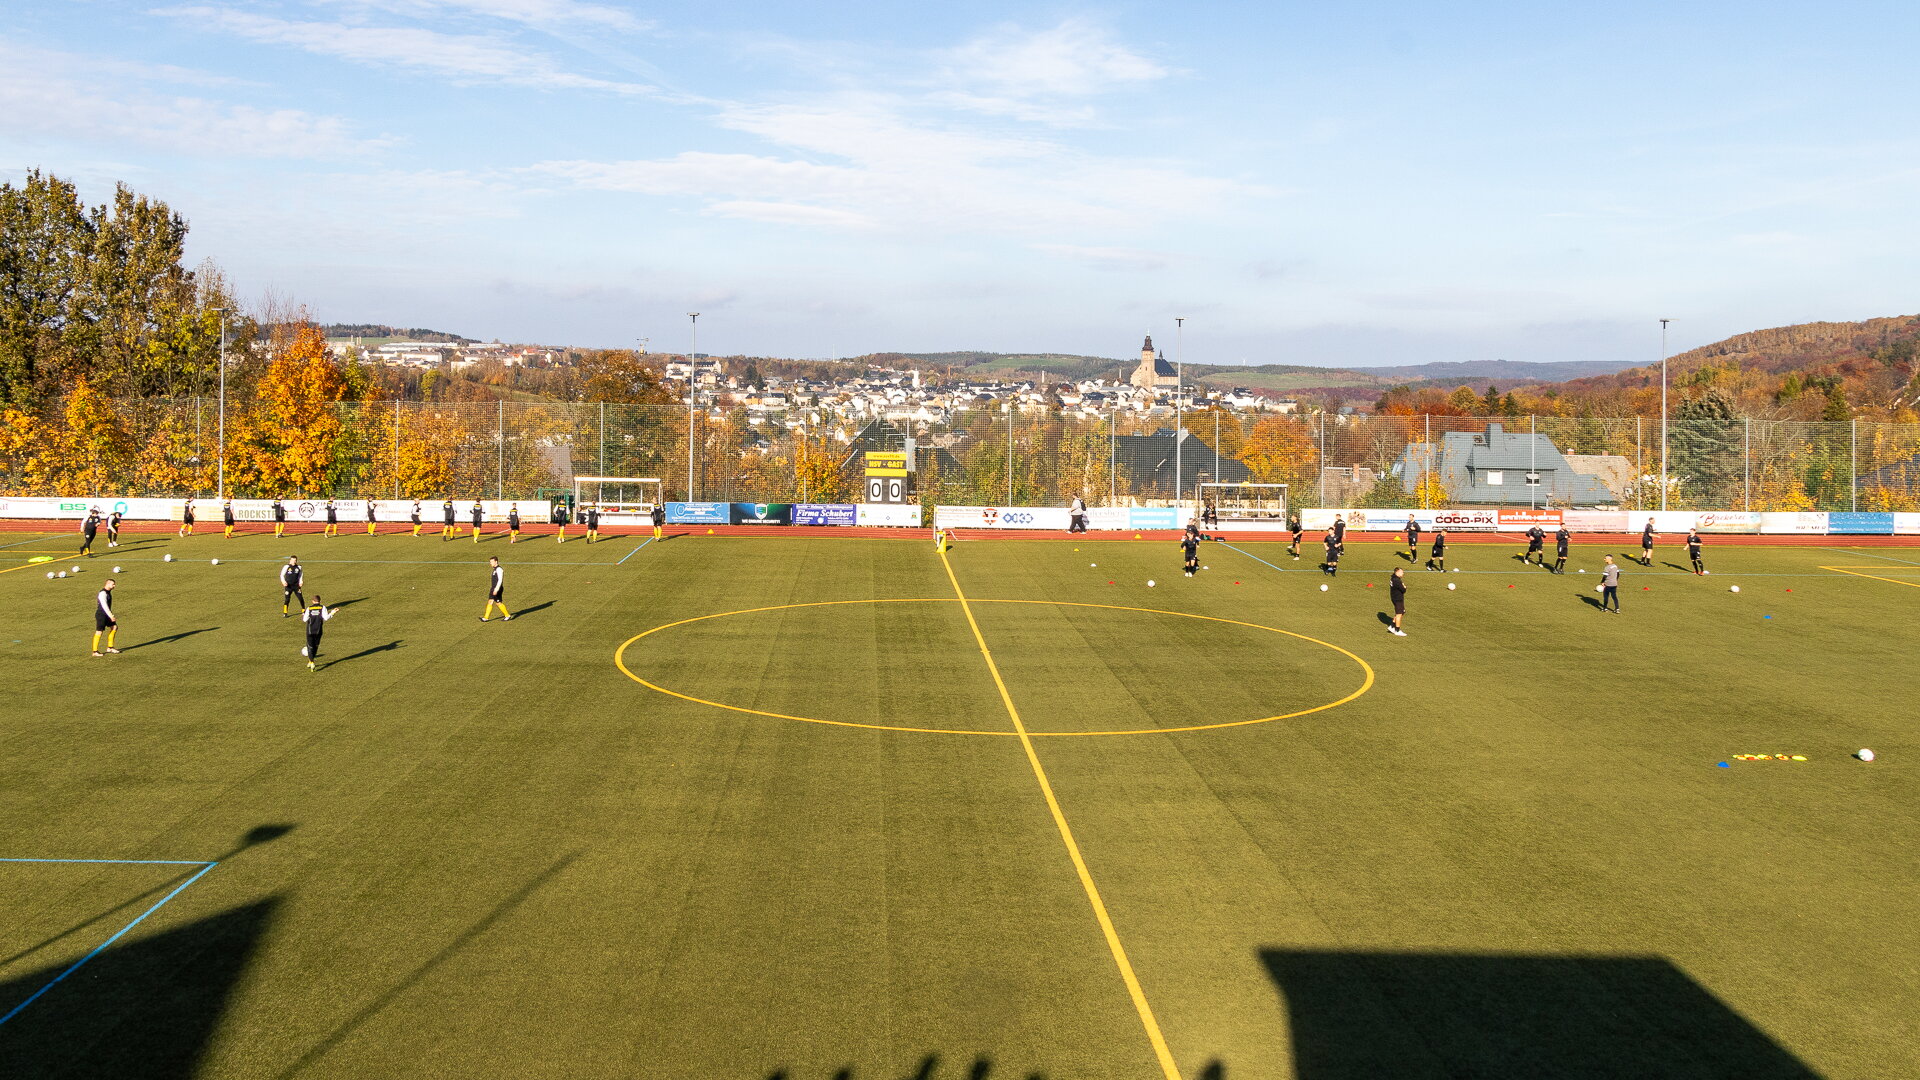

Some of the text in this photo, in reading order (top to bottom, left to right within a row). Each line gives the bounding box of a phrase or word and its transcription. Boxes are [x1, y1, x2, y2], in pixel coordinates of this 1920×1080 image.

[871, 482, 900, 498] 0 0
[796, 509, 854, 518] Firma Schubert
[1435, 516, 1494, 524] COCO-PIX
